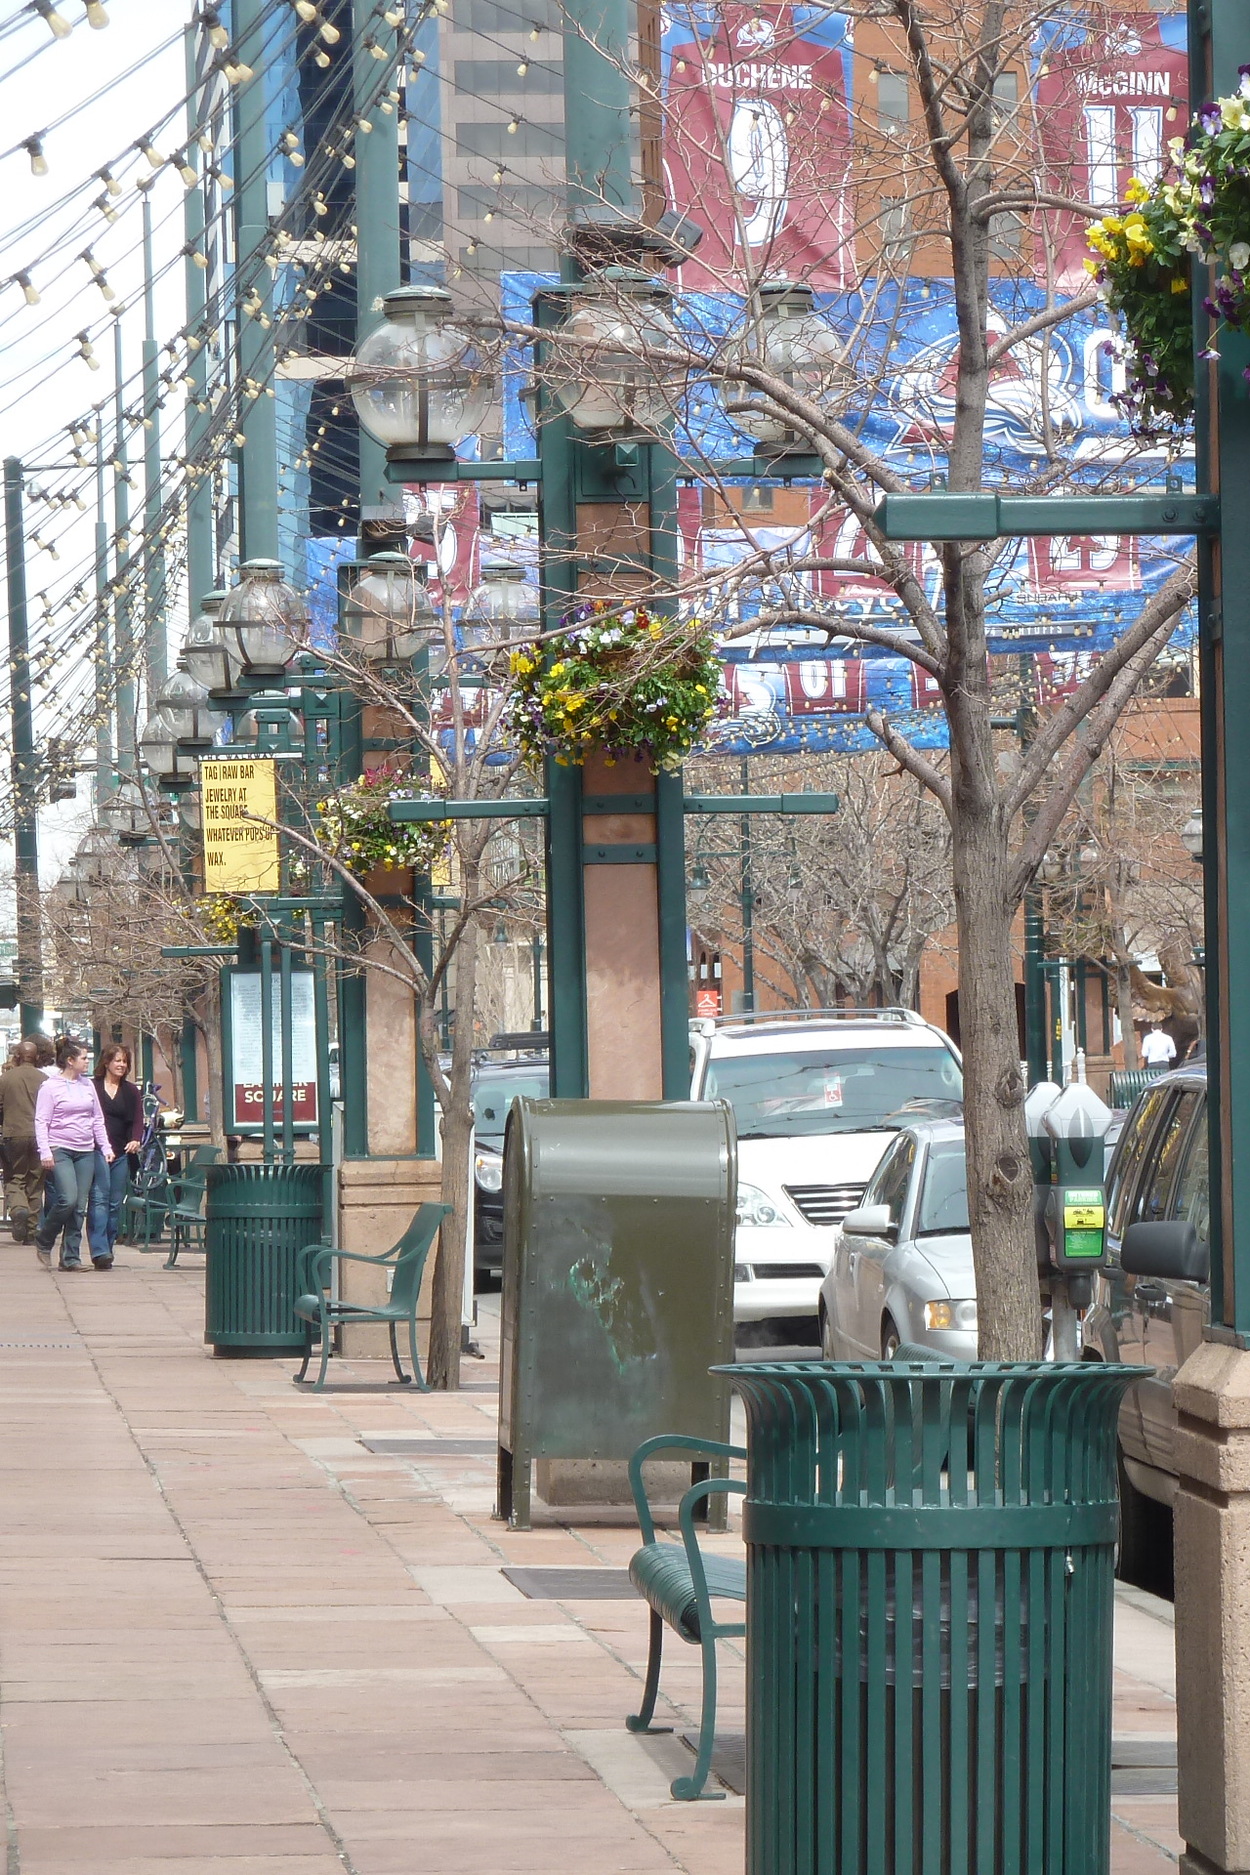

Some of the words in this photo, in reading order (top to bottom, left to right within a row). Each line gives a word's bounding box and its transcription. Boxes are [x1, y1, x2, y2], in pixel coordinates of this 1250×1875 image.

[701, 62, 813, 89] DUCHENE
[726, 97, 789, 247] 9
[204, 765, 218, 780] TAG
[222, 765, 239, 780] RAW
[240, 765, 254, 779] BAR
[205, 788, 237, 802] JEWELRY
[238, 788, 247, 802] AT
[206, 805, 220, 820] THE
[206, 827, 244, 842] WHATEVER
[245, 827, 263, 842] POPS
[207, 852, 227, 867] WAX.
